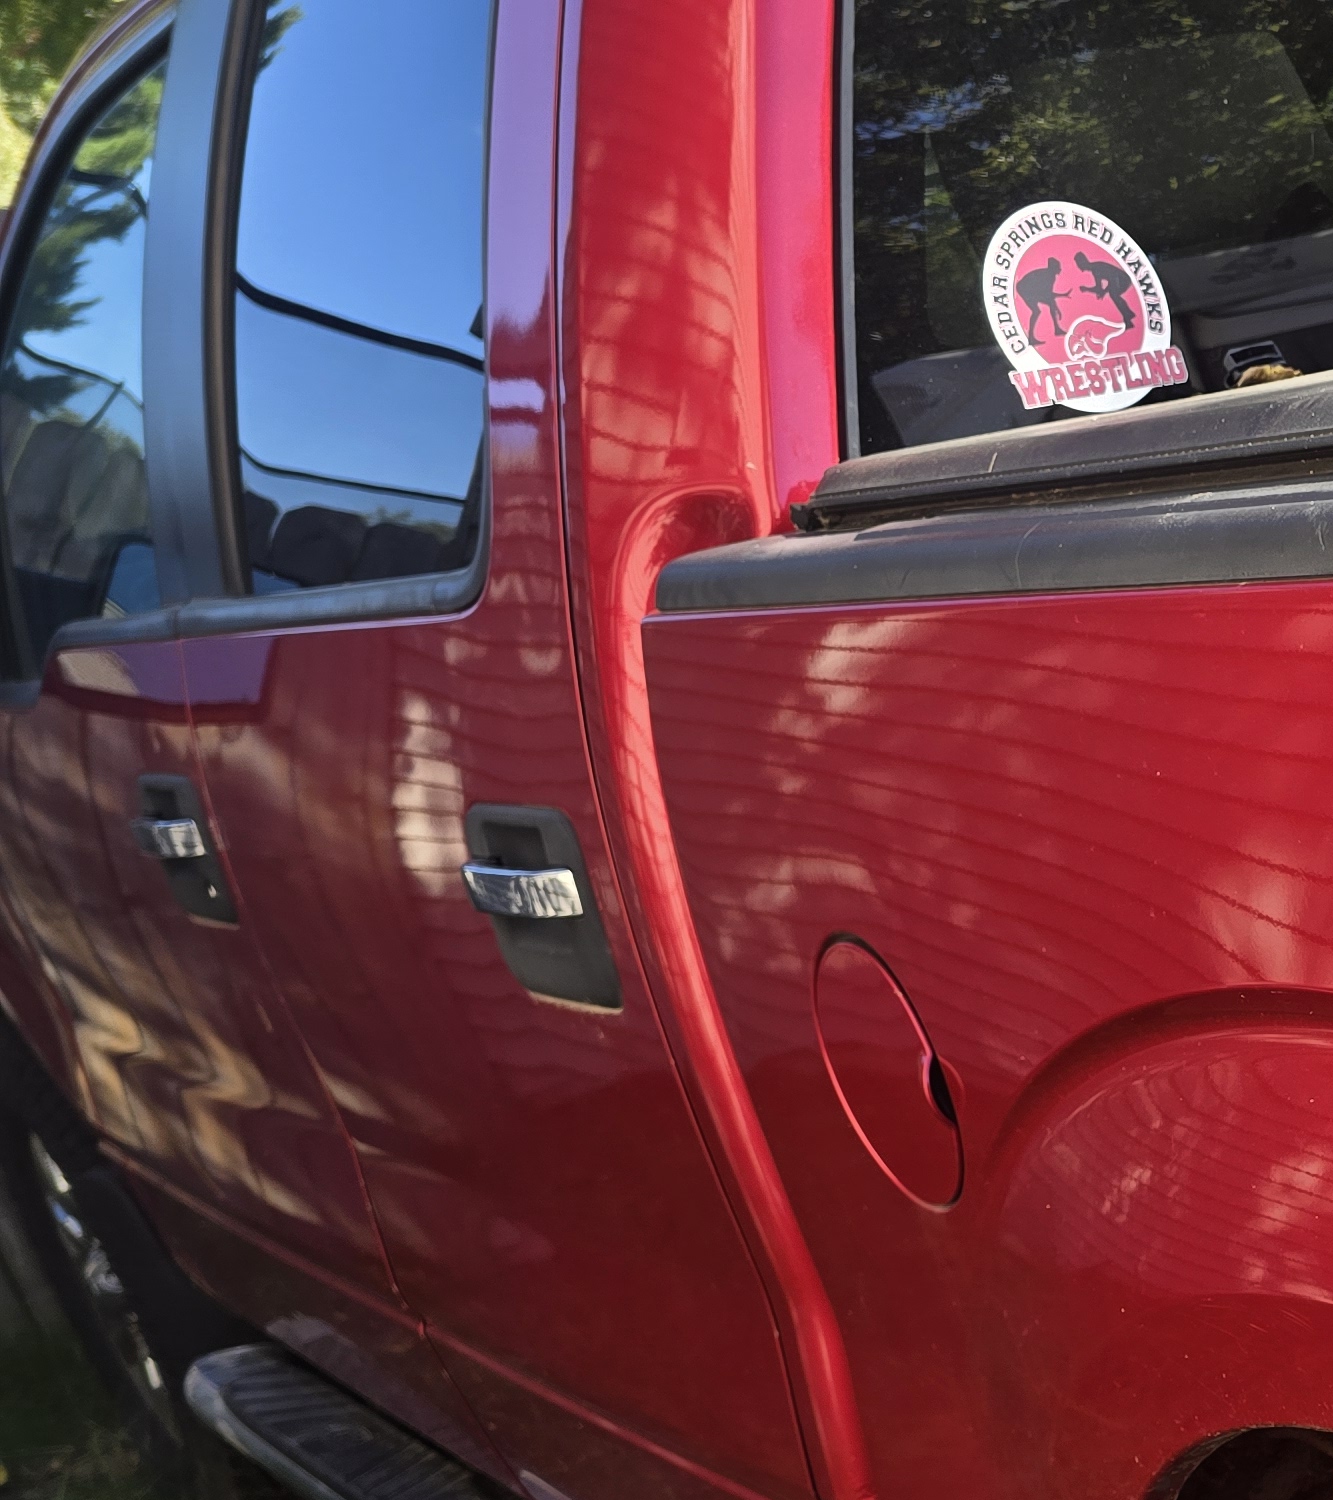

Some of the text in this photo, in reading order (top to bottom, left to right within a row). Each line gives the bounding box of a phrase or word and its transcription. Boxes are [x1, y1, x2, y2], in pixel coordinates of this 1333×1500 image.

[992, 211, 1166, 355] CEDAR SPRINGS RED HAWKS
[1010, 346, 1189, 409] WRESTLING
